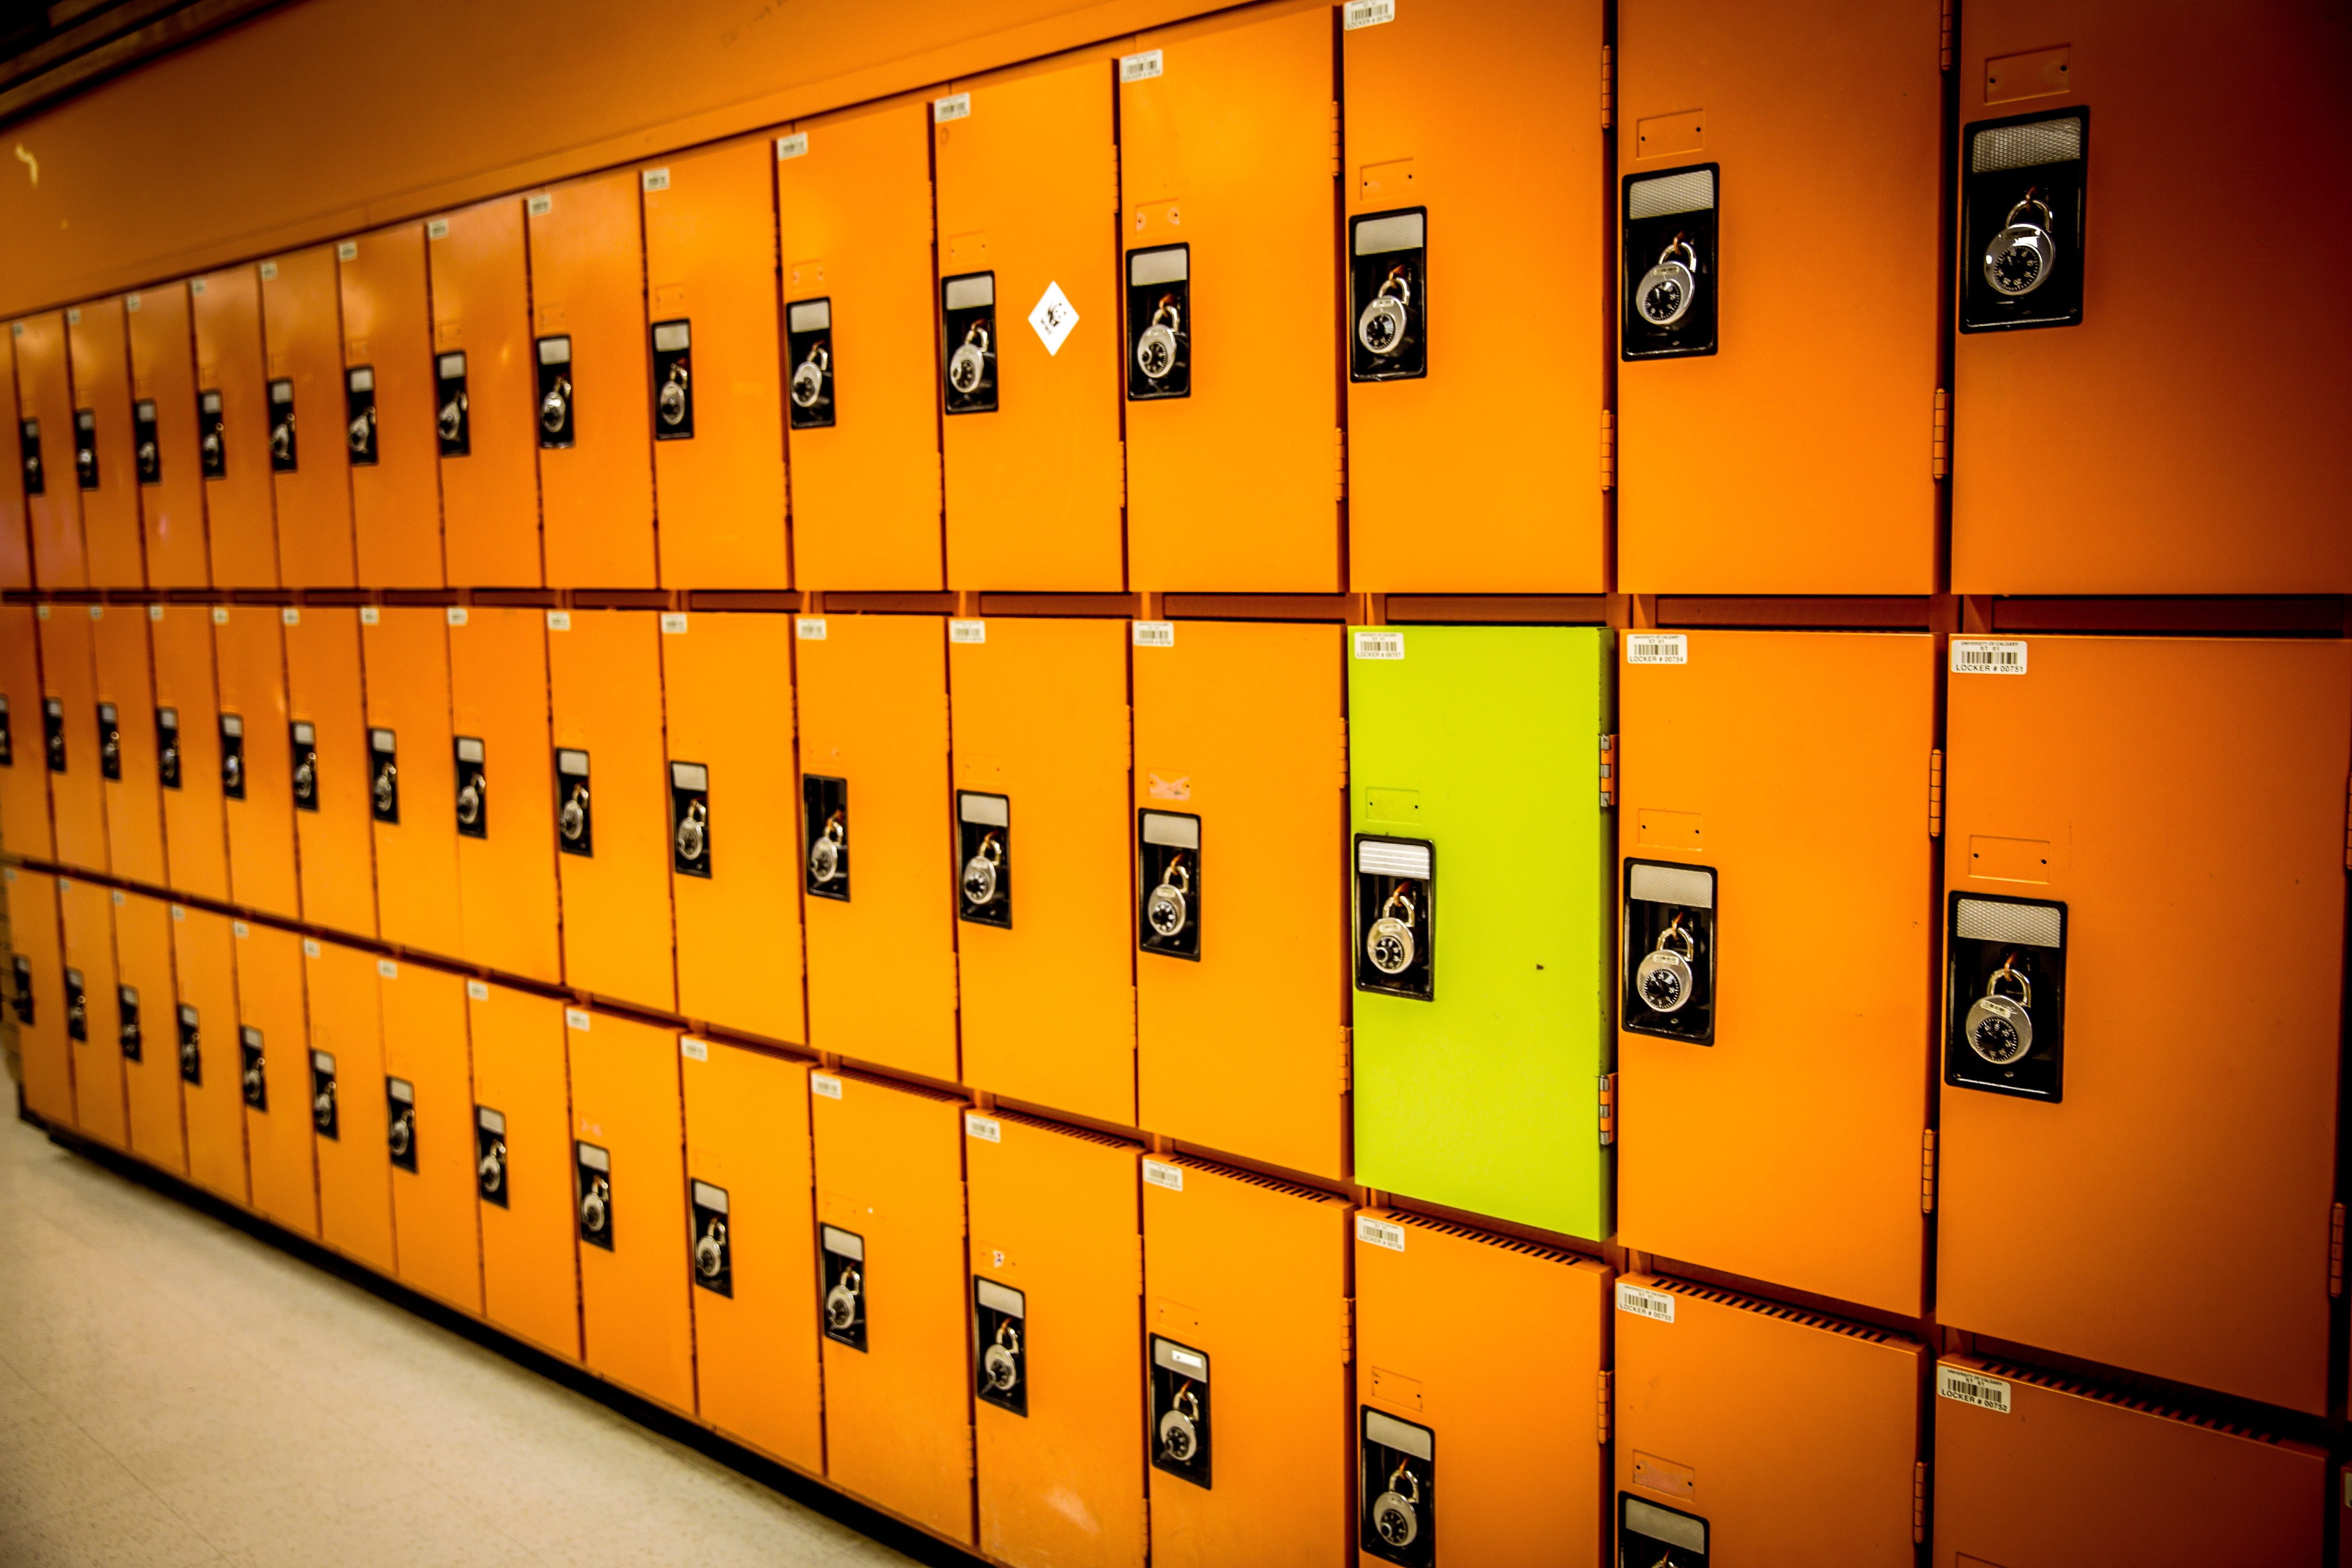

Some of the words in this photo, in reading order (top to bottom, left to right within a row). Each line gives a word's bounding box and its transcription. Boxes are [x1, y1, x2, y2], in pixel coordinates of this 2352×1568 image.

[1619, 1303, 1646, 1313] LOCKER
[1947, 1369, 1973, 1377] UNIVERSITY
[1980, 1377, 2002, 1386] CALGARY
[1942, 1388, 1975, 1403] LOCKER
[1984, 1401, 2008, 1412] 00752
